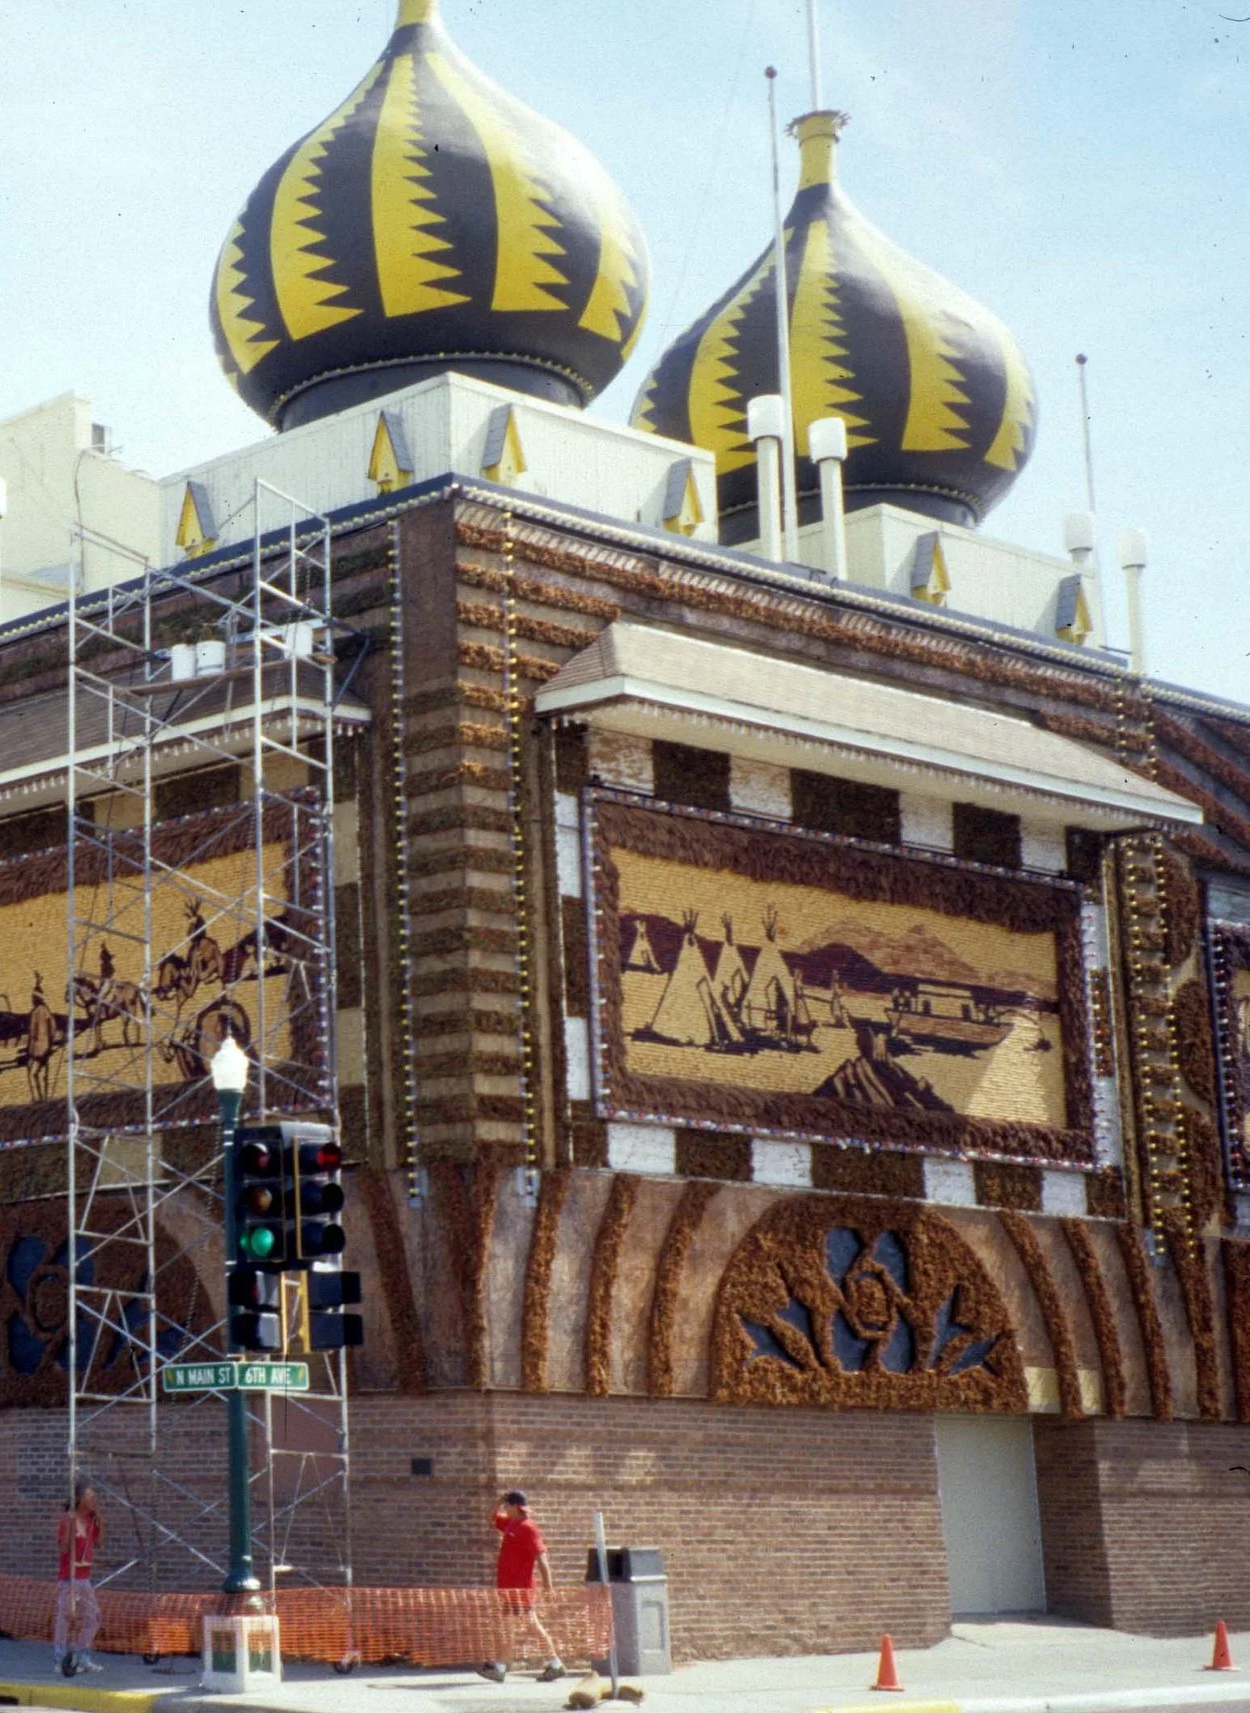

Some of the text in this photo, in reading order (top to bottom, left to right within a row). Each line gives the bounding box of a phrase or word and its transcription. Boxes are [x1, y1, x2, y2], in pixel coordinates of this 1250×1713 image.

[176, 1367, 231, 1386] N MAIN ST
[245, 1367, 292, 1385] 6TH AVE
